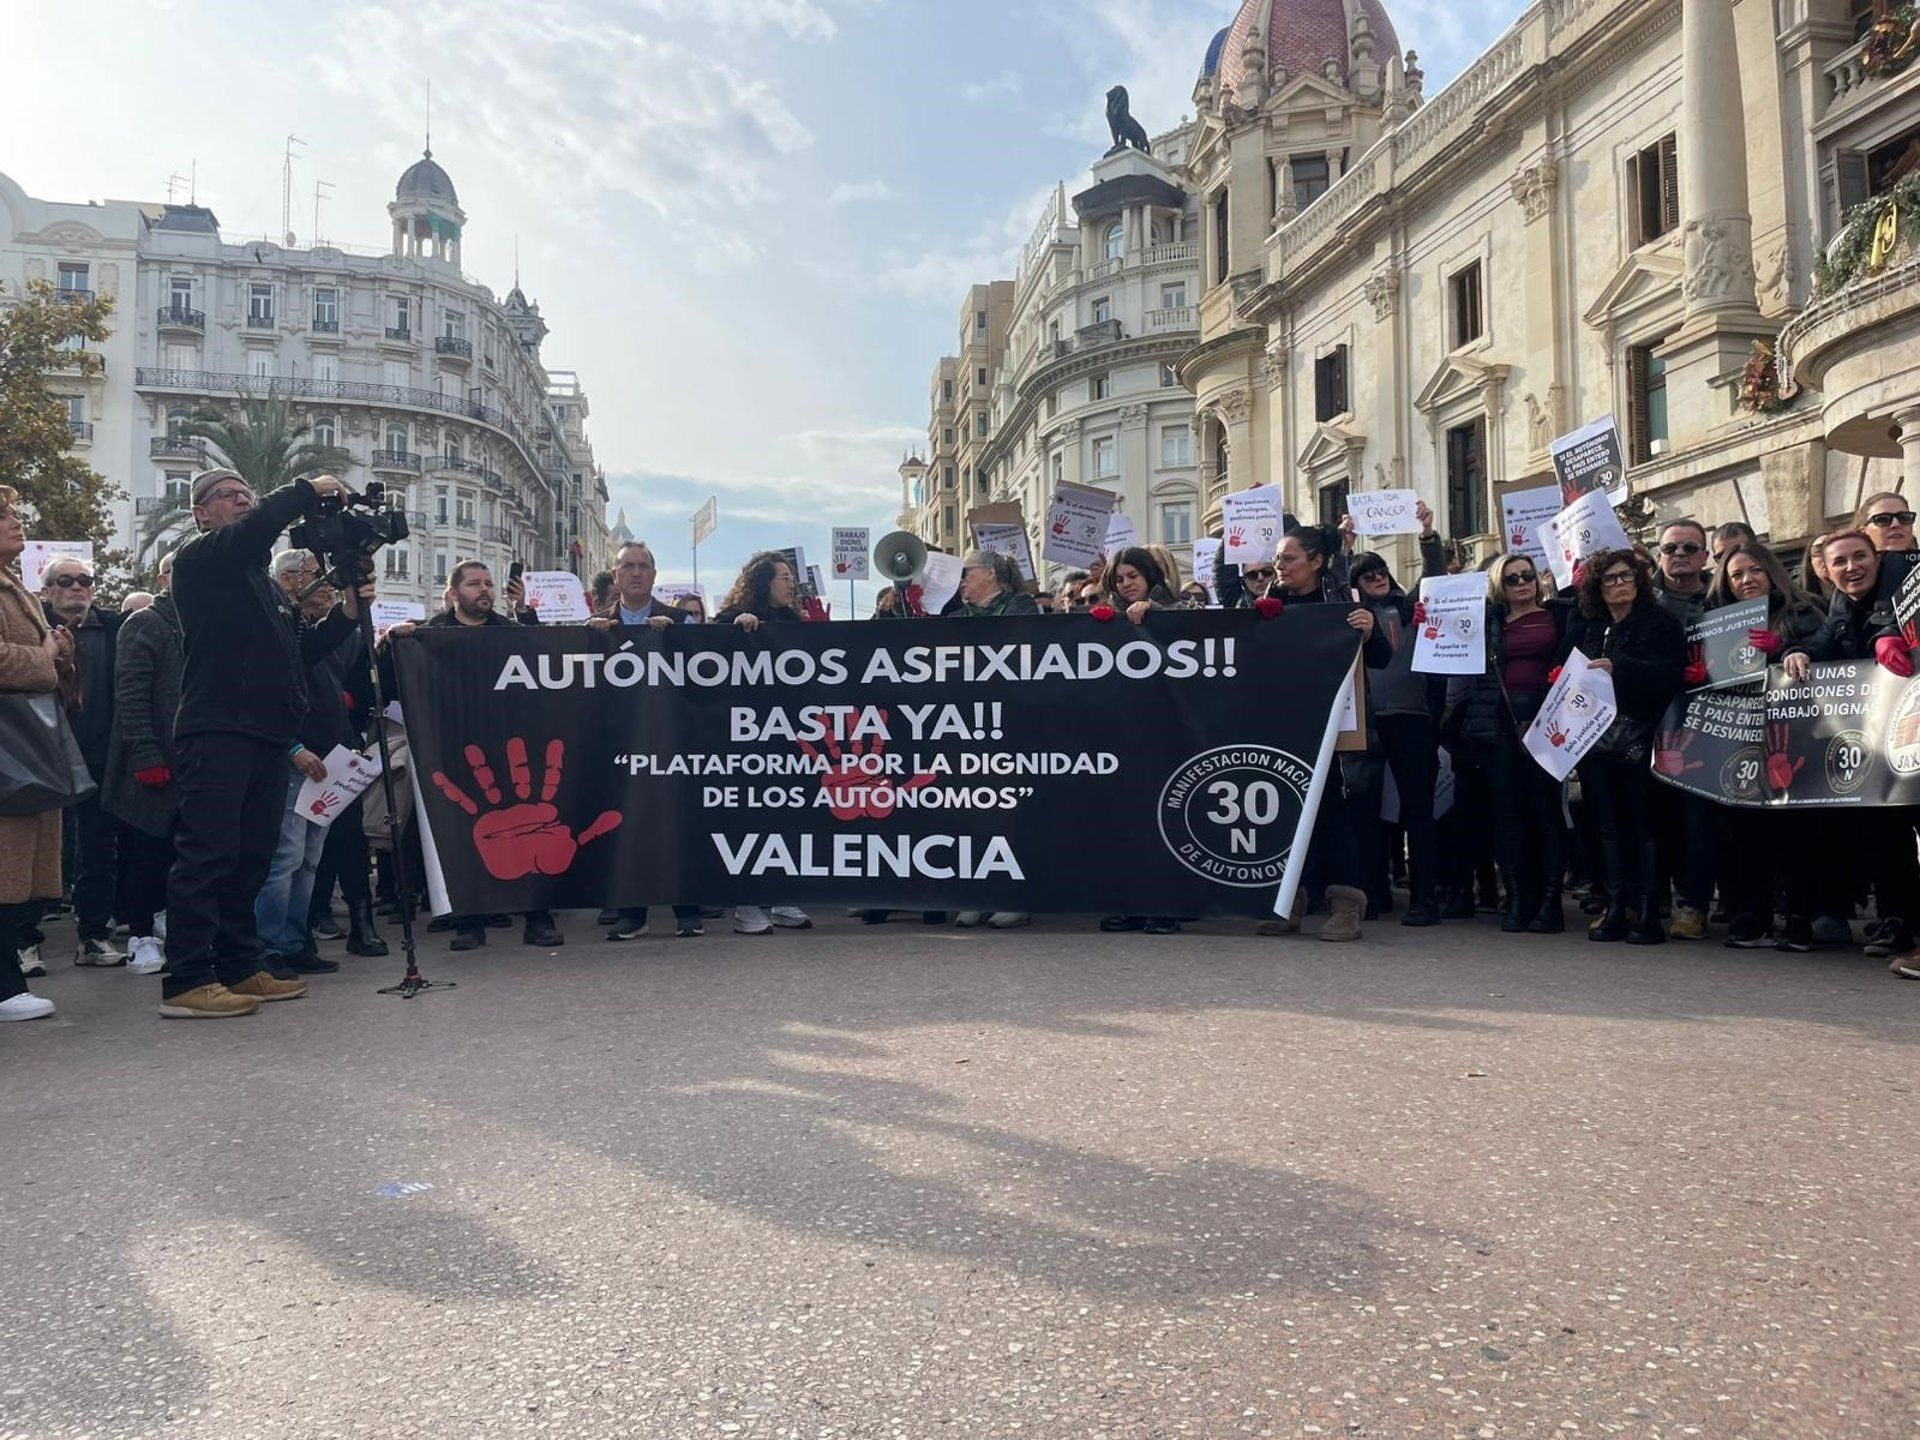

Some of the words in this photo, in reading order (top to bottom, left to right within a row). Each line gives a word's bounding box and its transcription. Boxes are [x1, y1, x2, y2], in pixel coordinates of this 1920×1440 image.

[1600, 470, 1613, 484] 30
[1085, 525, 1096, 534] 30
[1261, 528, 1273, 537] 30
[1579, 529, 1591, 541] 30
[1460, 619, 1471, 628] 30
[1687, 626, 1724, 643] PEDIMOS
[1725, 615, 1766, 631] JUSTICIA
[1739, 646, 1755, 660] 30
[494, 640, 849, 691] AUTÓNOMOS
[860, 638, 1237, 684] ASFIXIADOS!!
[1815, 666, 1856, 680] UNAS
[1571, 694, 1585, 709] 30
[1765, 684, 1855, 703] CONDICIONES
[1860, 683, 1880, 696] DE
[1687, 702, 1702, 715] EL
[1704, 707, 1735, 724] PAÍS
[1766, 705, 1820, 720] TRABAJO
[1823, 703, 1880, 716] DIGNAS
[731, 705, 892, 742] BASTA
[897, 702, 1004, 741] YA!!
[1575, 719, 1595, 742] justicia
[1593, 705, 1608, 721] para
[1683, 716, 1701, 730] SE
[841, 753, 906, 775] POR
[914, 753, 953, 775] LA
[960, 752, 1119, 775] DIGNIDAD
[1838, 746, 1862, 769] 30
[1736, 760, 1759, 780] 30
[1843, 770, 1853, 781] N
[1167, 752, 1270, 809] MANIFESTACION
[1739, 779, 1748, 790] N
[704, 786, 739, 808] DE
[747, 786, 806, 808] LOS
[1207, 780, 1280, 825] 30
[1230, 828, 1256, 854] N
[710, 832, 1026, 881] VALENCIA
[1180, 843, 1203, 862] DE
